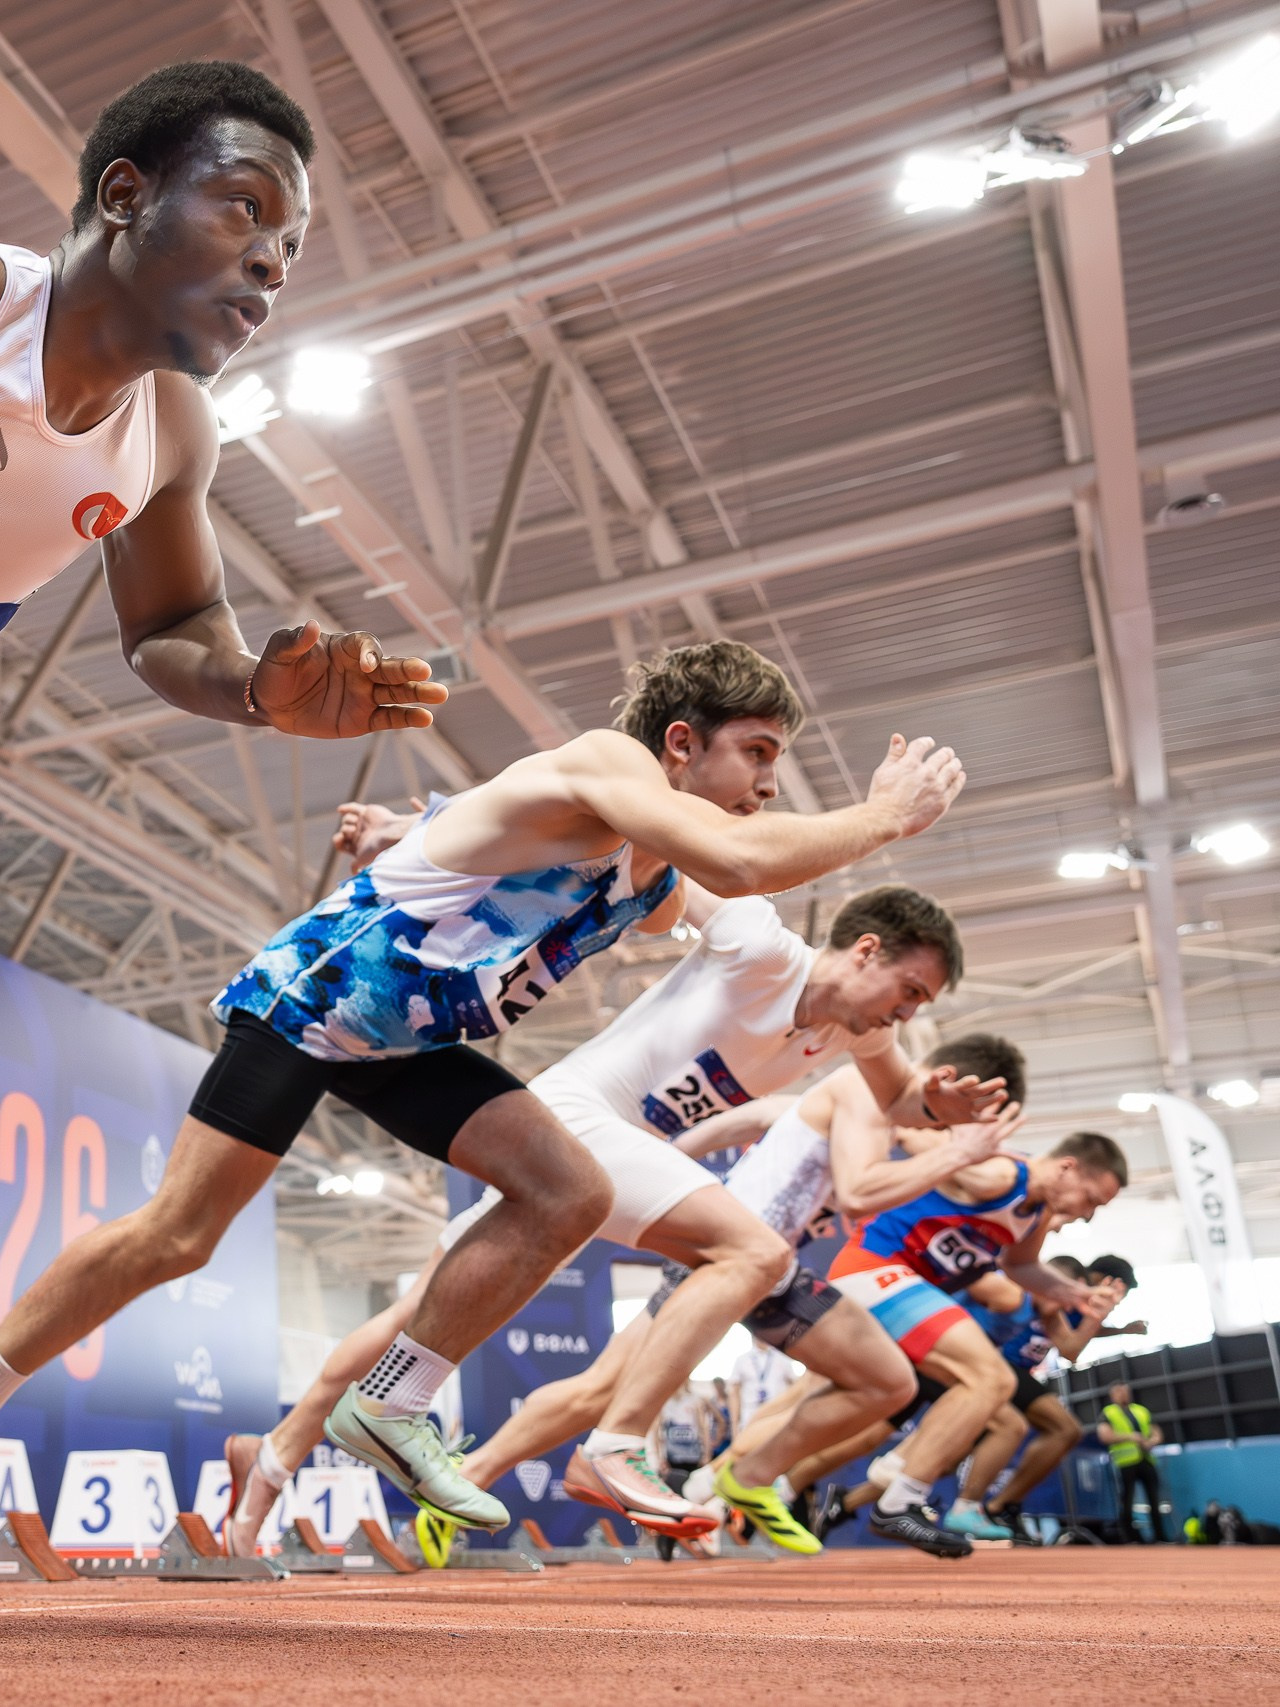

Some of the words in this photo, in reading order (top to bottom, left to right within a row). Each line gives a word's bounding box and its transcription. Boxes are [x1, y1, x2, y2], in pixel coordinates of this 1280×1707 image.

[81, 1476, 112, 1534] 3
[145, 1476, 166, 1533] 3
[314, 1487, 331, 1534] 1
